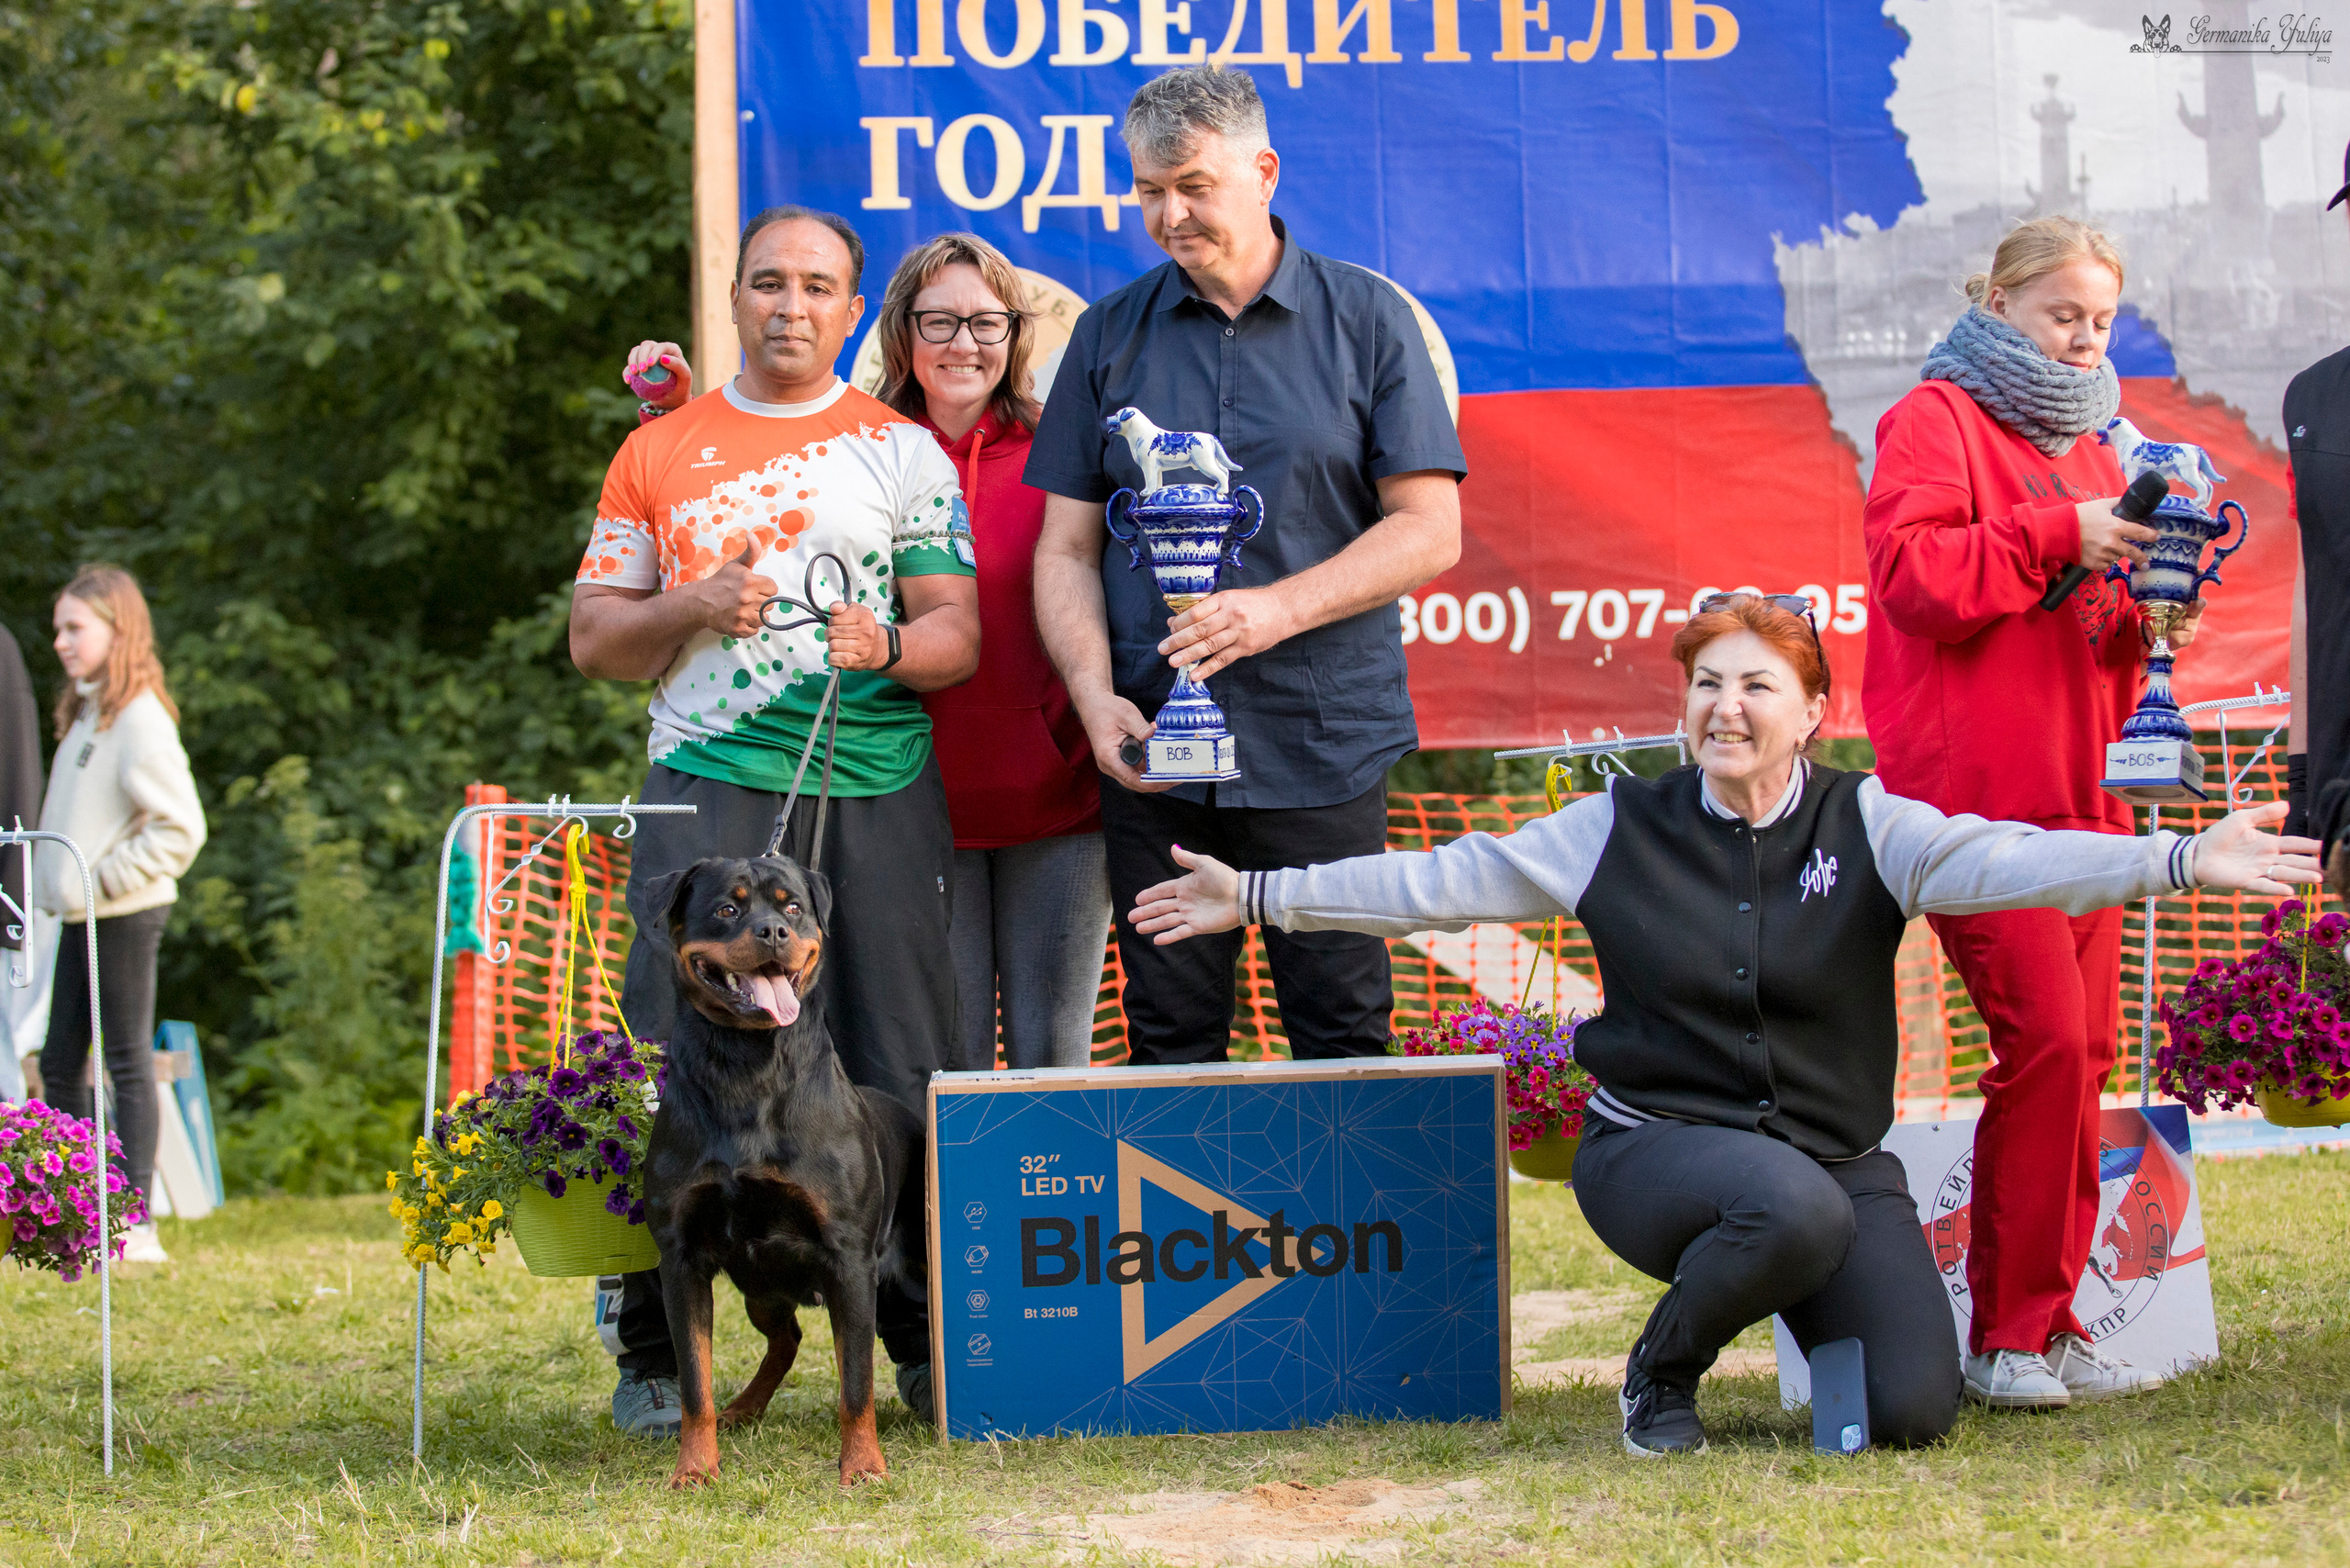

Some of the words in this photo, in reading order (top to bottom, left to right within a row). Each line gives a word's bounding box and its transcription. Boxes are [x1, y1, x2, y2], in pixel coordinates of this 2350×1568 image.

[859, 0, 1740, 89] ПОБЕДИТЕЛЬ
[860, 113, 1140, 232] ГОД
[690, 461, 726, 469] TRIUMPH
[1167, 746, 1193, 761] BOB
[2129, 753, 2155, 767] BOS
[1022, 1177, 1068, 1196] LED
[1075, 1175, 1105, 1193] TV
[1936, 1157, 1974, 1296] РОТВЕЙЛ
[2120, 1161, 2167, 1282] РОССИИ
[1020, 1208, 1404, 1288] Blackton
[1024, 1308, 1038, 1319] Bt
[1041, 1306, 1079, 1318] 3210B
